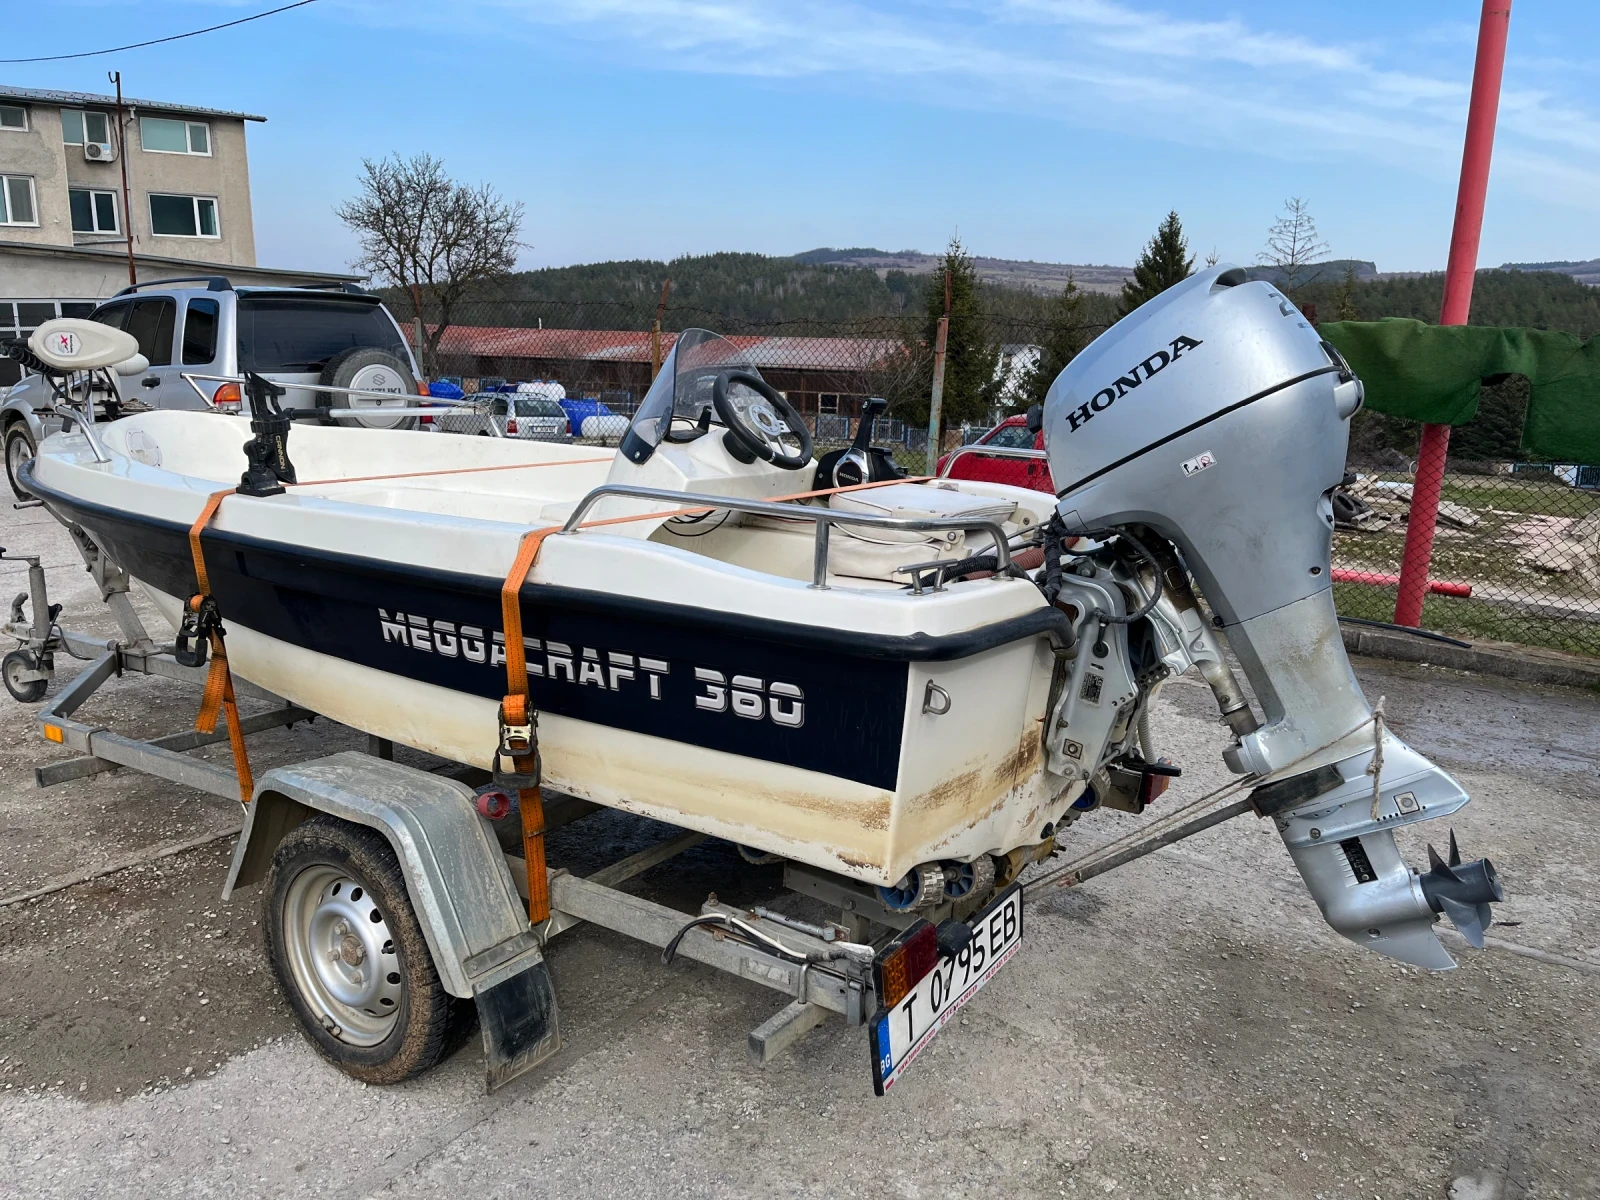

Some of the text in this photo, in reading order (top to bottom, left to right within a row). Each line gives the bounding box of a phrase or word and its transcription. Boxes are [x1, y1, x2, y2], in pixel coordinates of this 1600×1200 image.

[1065, 335, 1204, 433] HONDA
[275, 434, 286, 470] CANNON
[839, 472, 860, 482] HONDA
[377, 608, 805, 729] MEGGACRAFT 360
[902, 991, 918, 1043] T
[881, 1053, 891, 1075] BG
